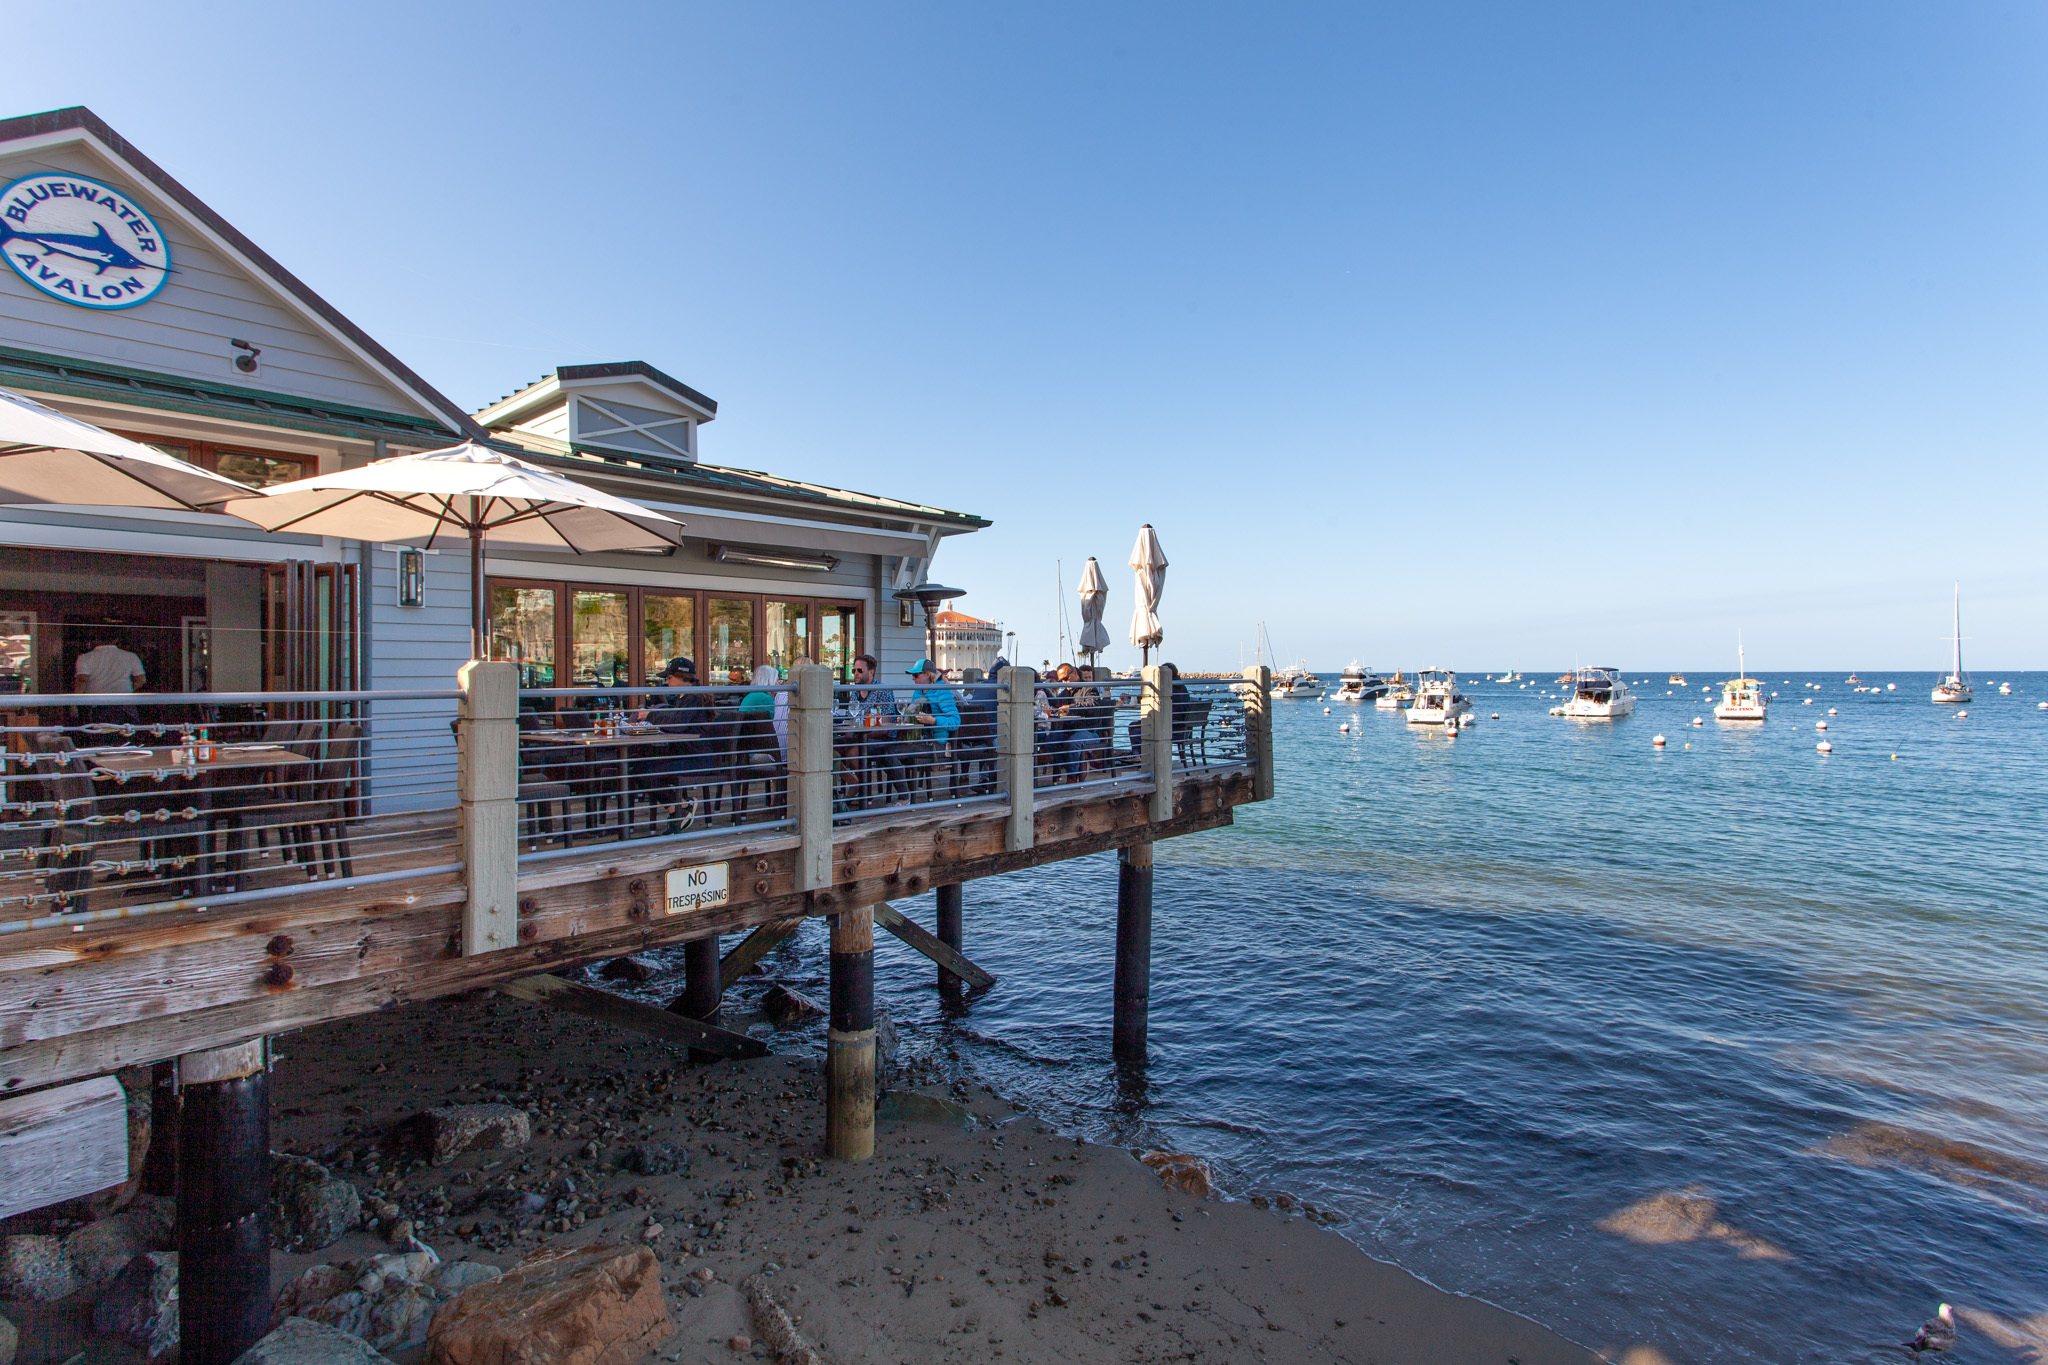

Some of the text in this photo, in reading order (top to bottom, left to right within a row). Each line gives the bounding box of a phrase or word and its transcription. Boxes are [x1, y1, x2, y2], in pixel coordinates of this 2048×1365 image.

[6, 183, 157, 253] BLUEWATER
[16, 253, 145, 300] AVALON
[688, 871, 707, 887] NO
[668, 888, 727, 909] TRESPASSING
